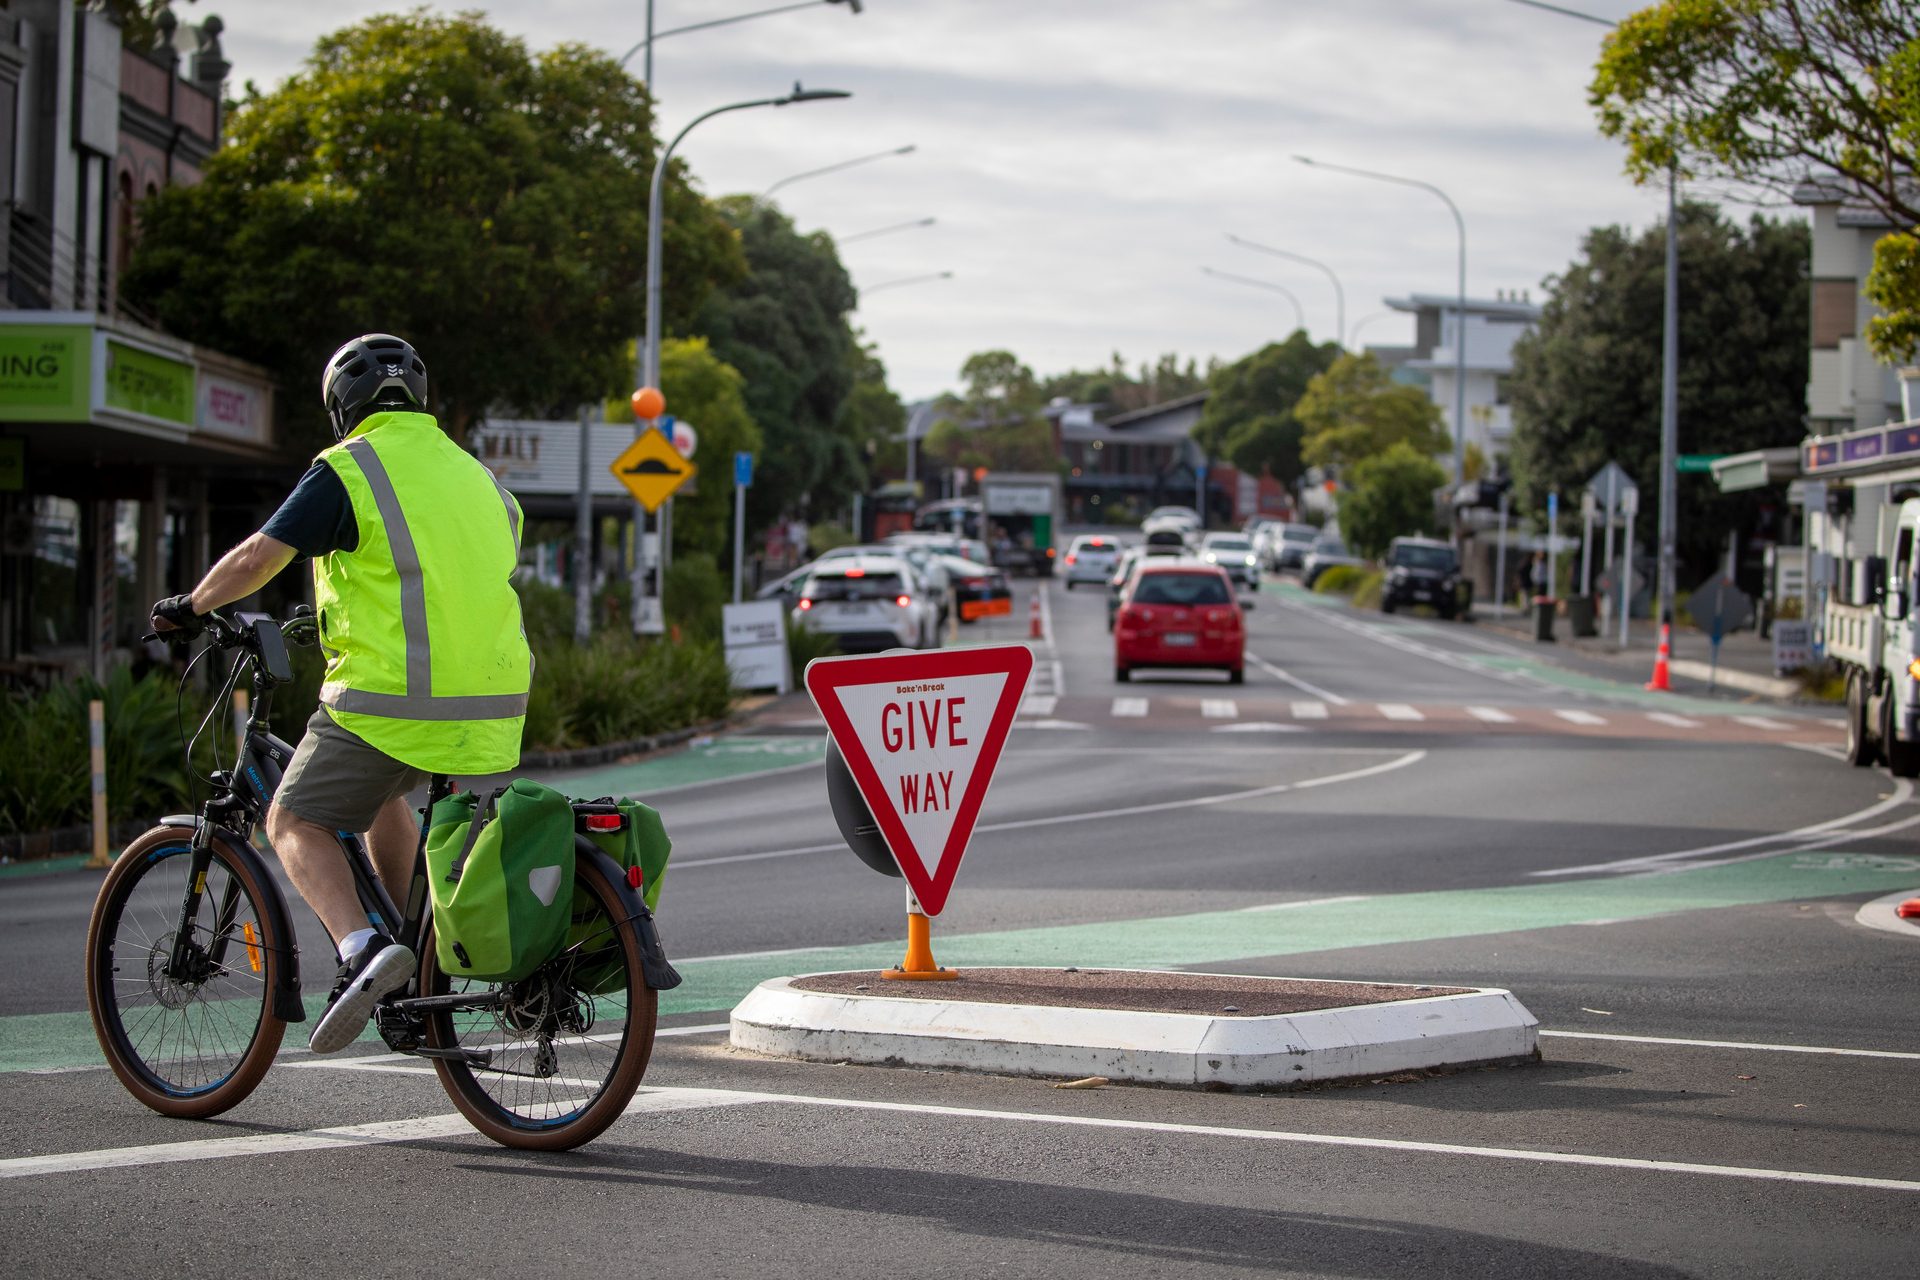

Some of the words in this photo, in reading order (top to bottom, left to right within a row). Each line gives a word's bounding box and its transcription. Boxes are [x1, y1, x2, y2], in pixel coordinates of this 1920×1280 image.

[881, 696, 968, 754] GIVE
[269, 748, 281, 760] 26
[247, 766, 264, 791] Metro
[900, 770, 954, 815] WAY
